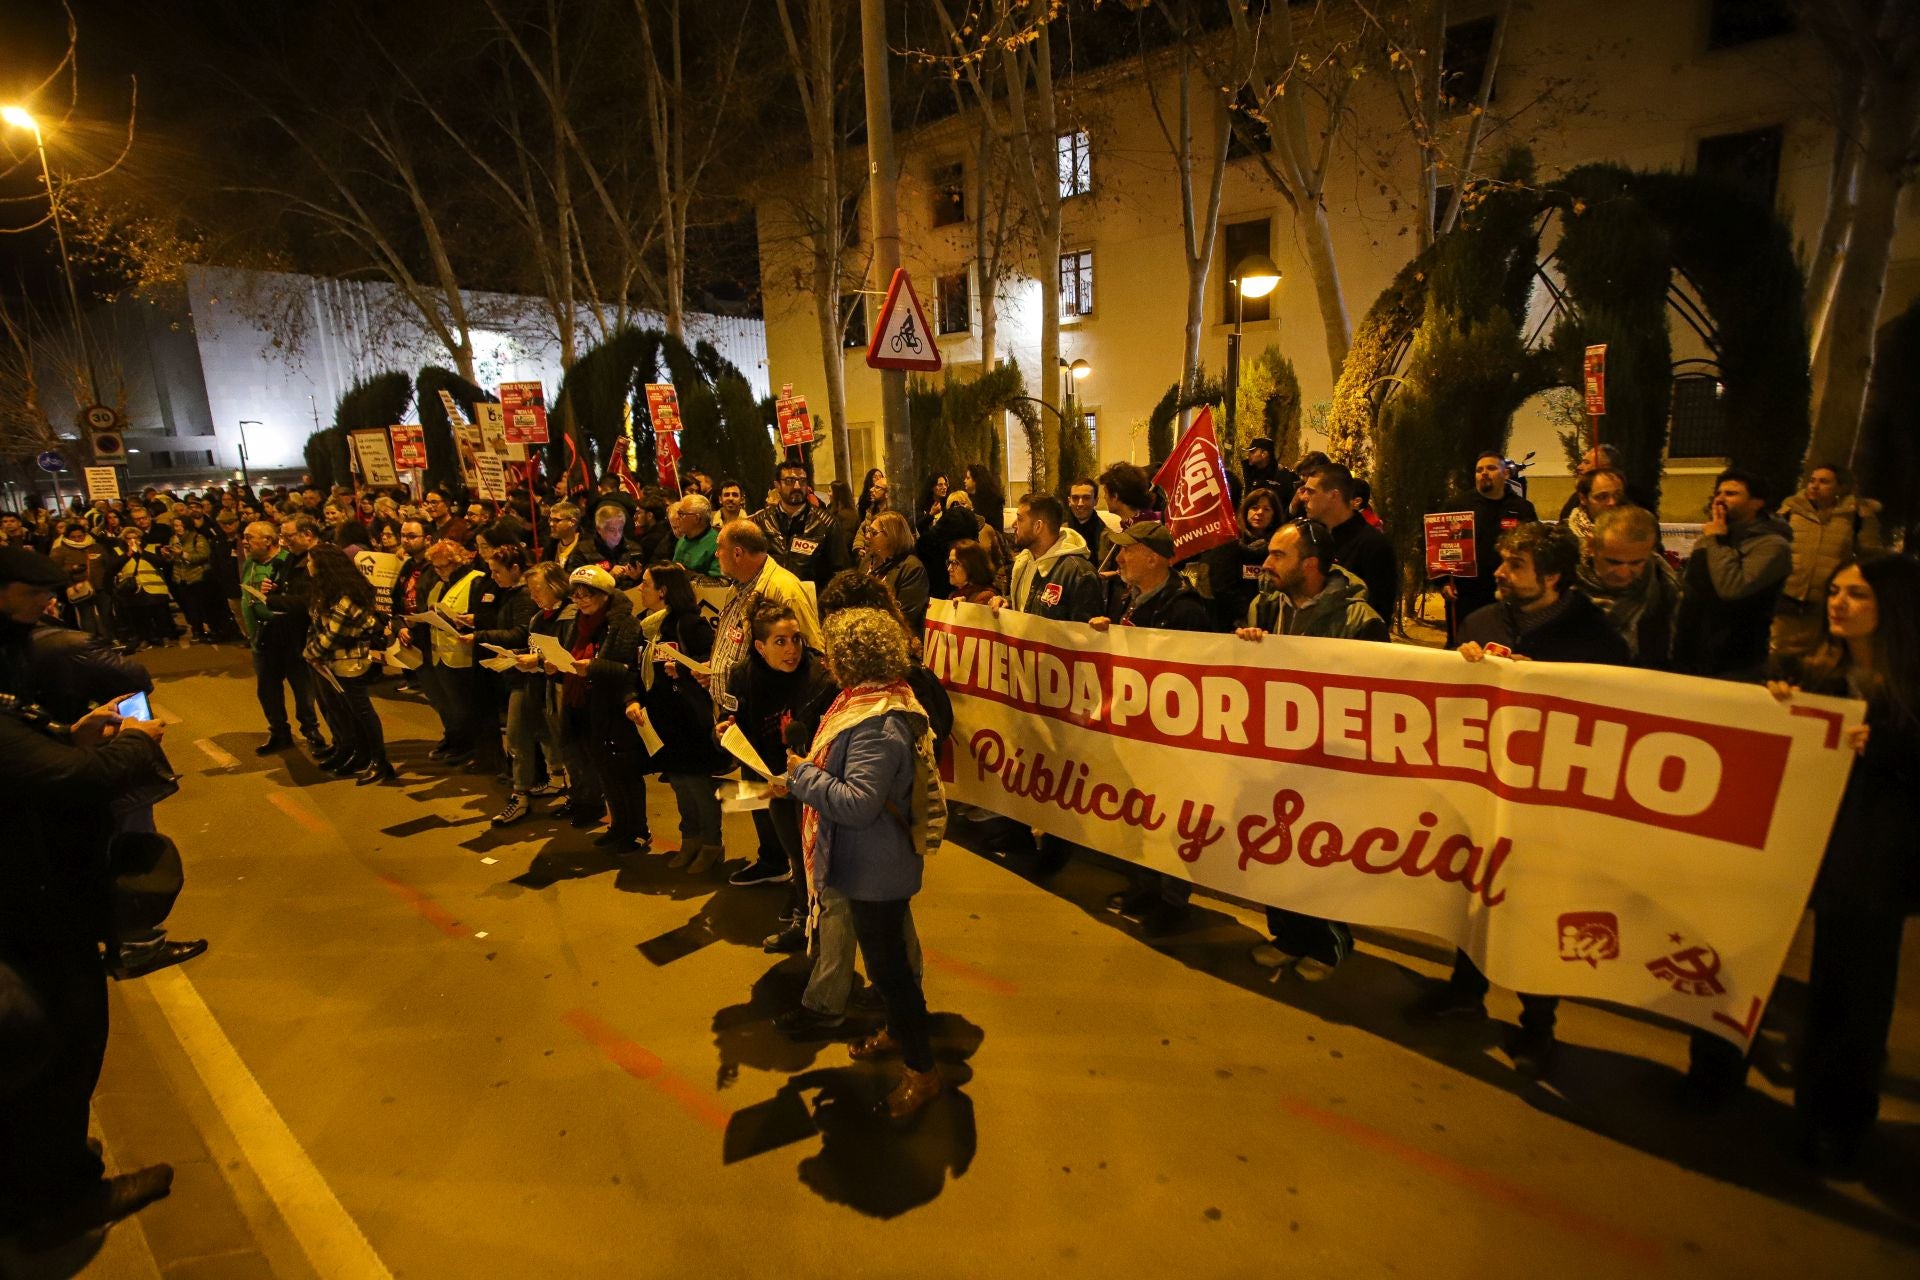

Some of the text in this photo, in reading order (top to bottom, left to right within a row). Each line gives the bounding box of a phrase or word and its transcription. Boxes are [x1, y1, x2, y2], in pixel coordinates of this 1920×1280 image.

[92, 413, 111, 422] 30
[1183, 442, 1221, 505] UGT
[794, 540, 815, 550] NO+
[923, 627, 1723, 817] VIVIENDA POR DERECHO
[969, 728, 1513, 908] Pública y Social
[1652, 966, 1714, 997] PCE
